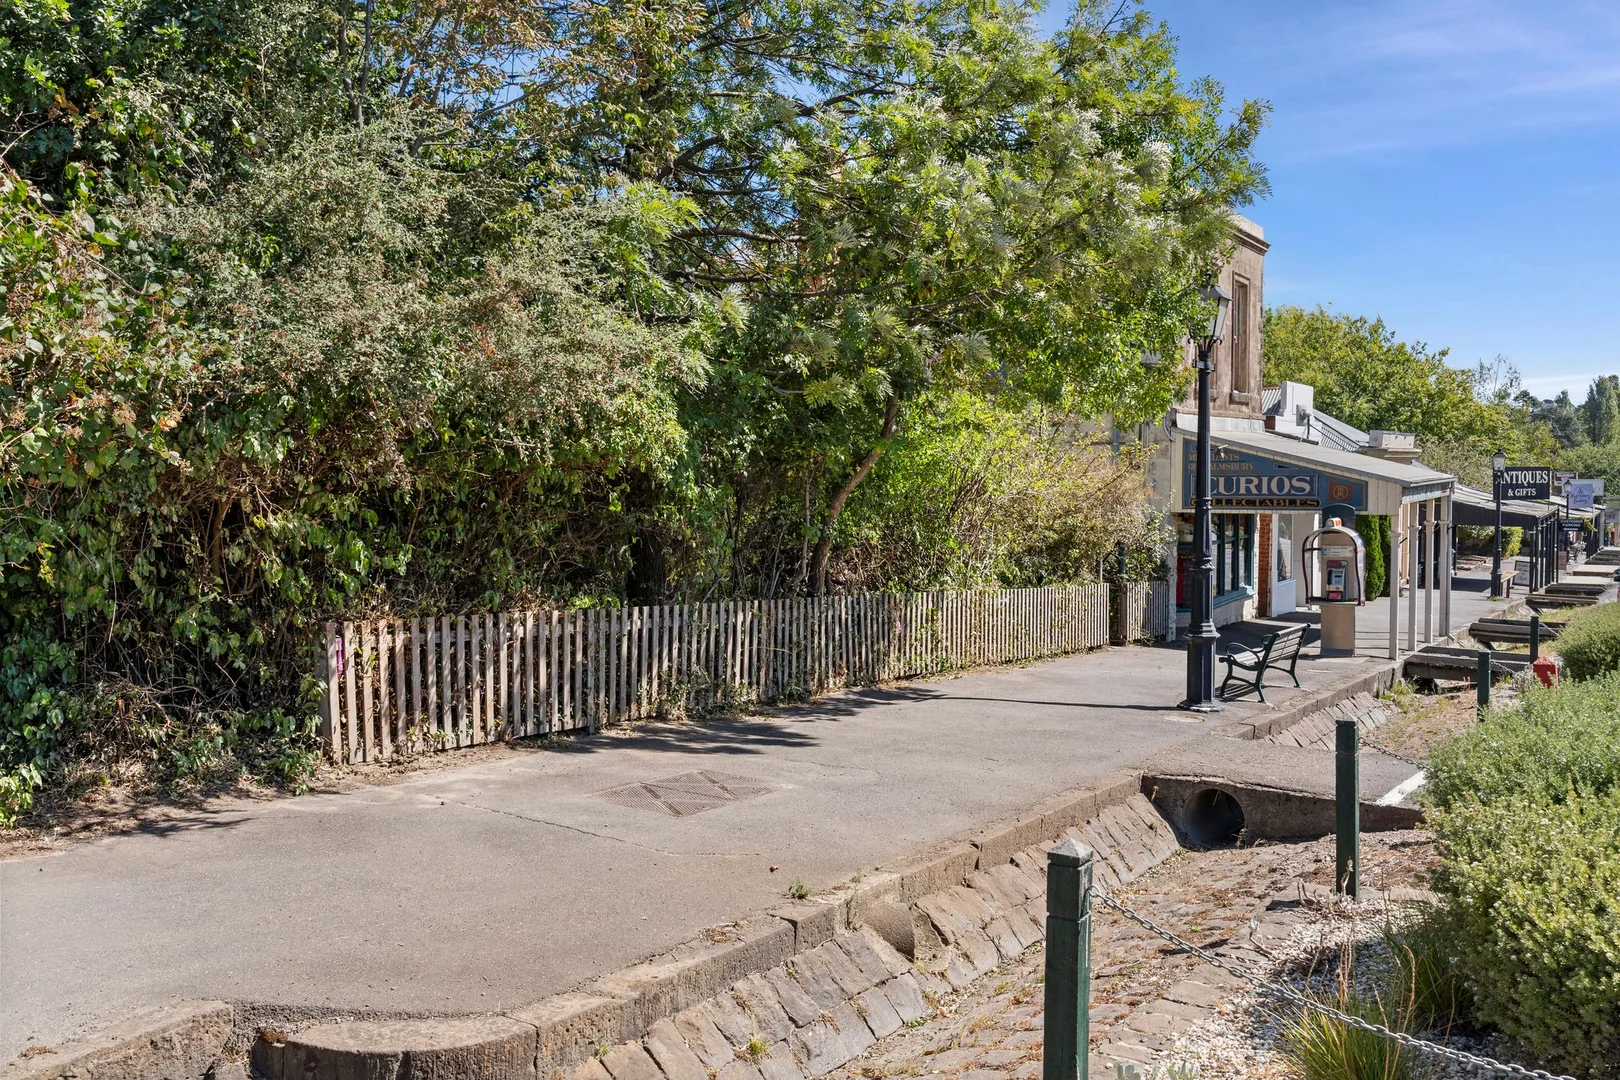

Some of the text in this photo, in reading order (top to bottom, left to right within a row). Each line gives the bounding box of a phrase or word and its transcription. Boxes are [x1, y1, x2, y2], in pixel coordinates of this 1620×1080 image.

[1507, 488, 1536, 496] & GIFTS
[1191, 498, 1318, 507] CLLECTABLES
